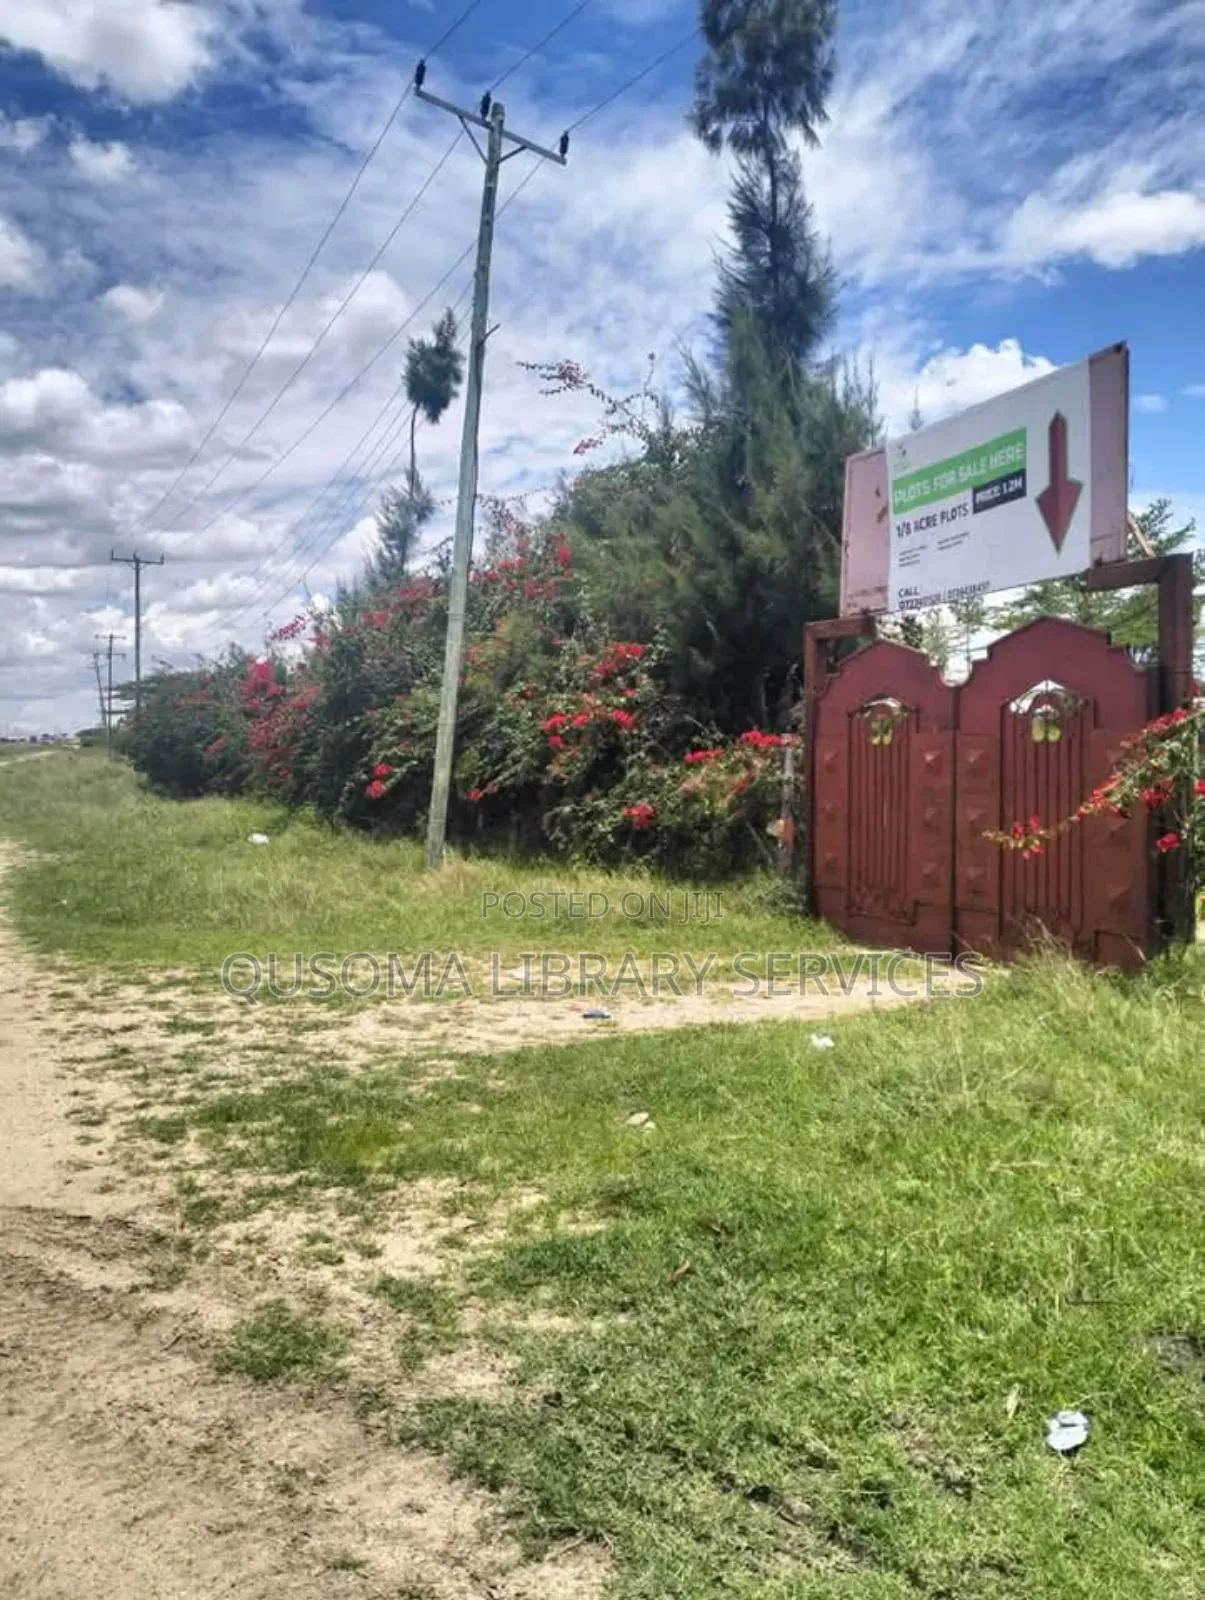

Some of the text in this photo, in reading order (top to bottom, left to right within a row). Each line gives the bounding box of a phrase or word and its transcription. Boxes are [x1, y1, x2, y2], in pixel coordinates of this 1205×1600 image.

[894, 441, 1024, 506] PLOTS FOR SALE HERE
[896, 502, 969, 538] 1/8 ACRE PLOTS
